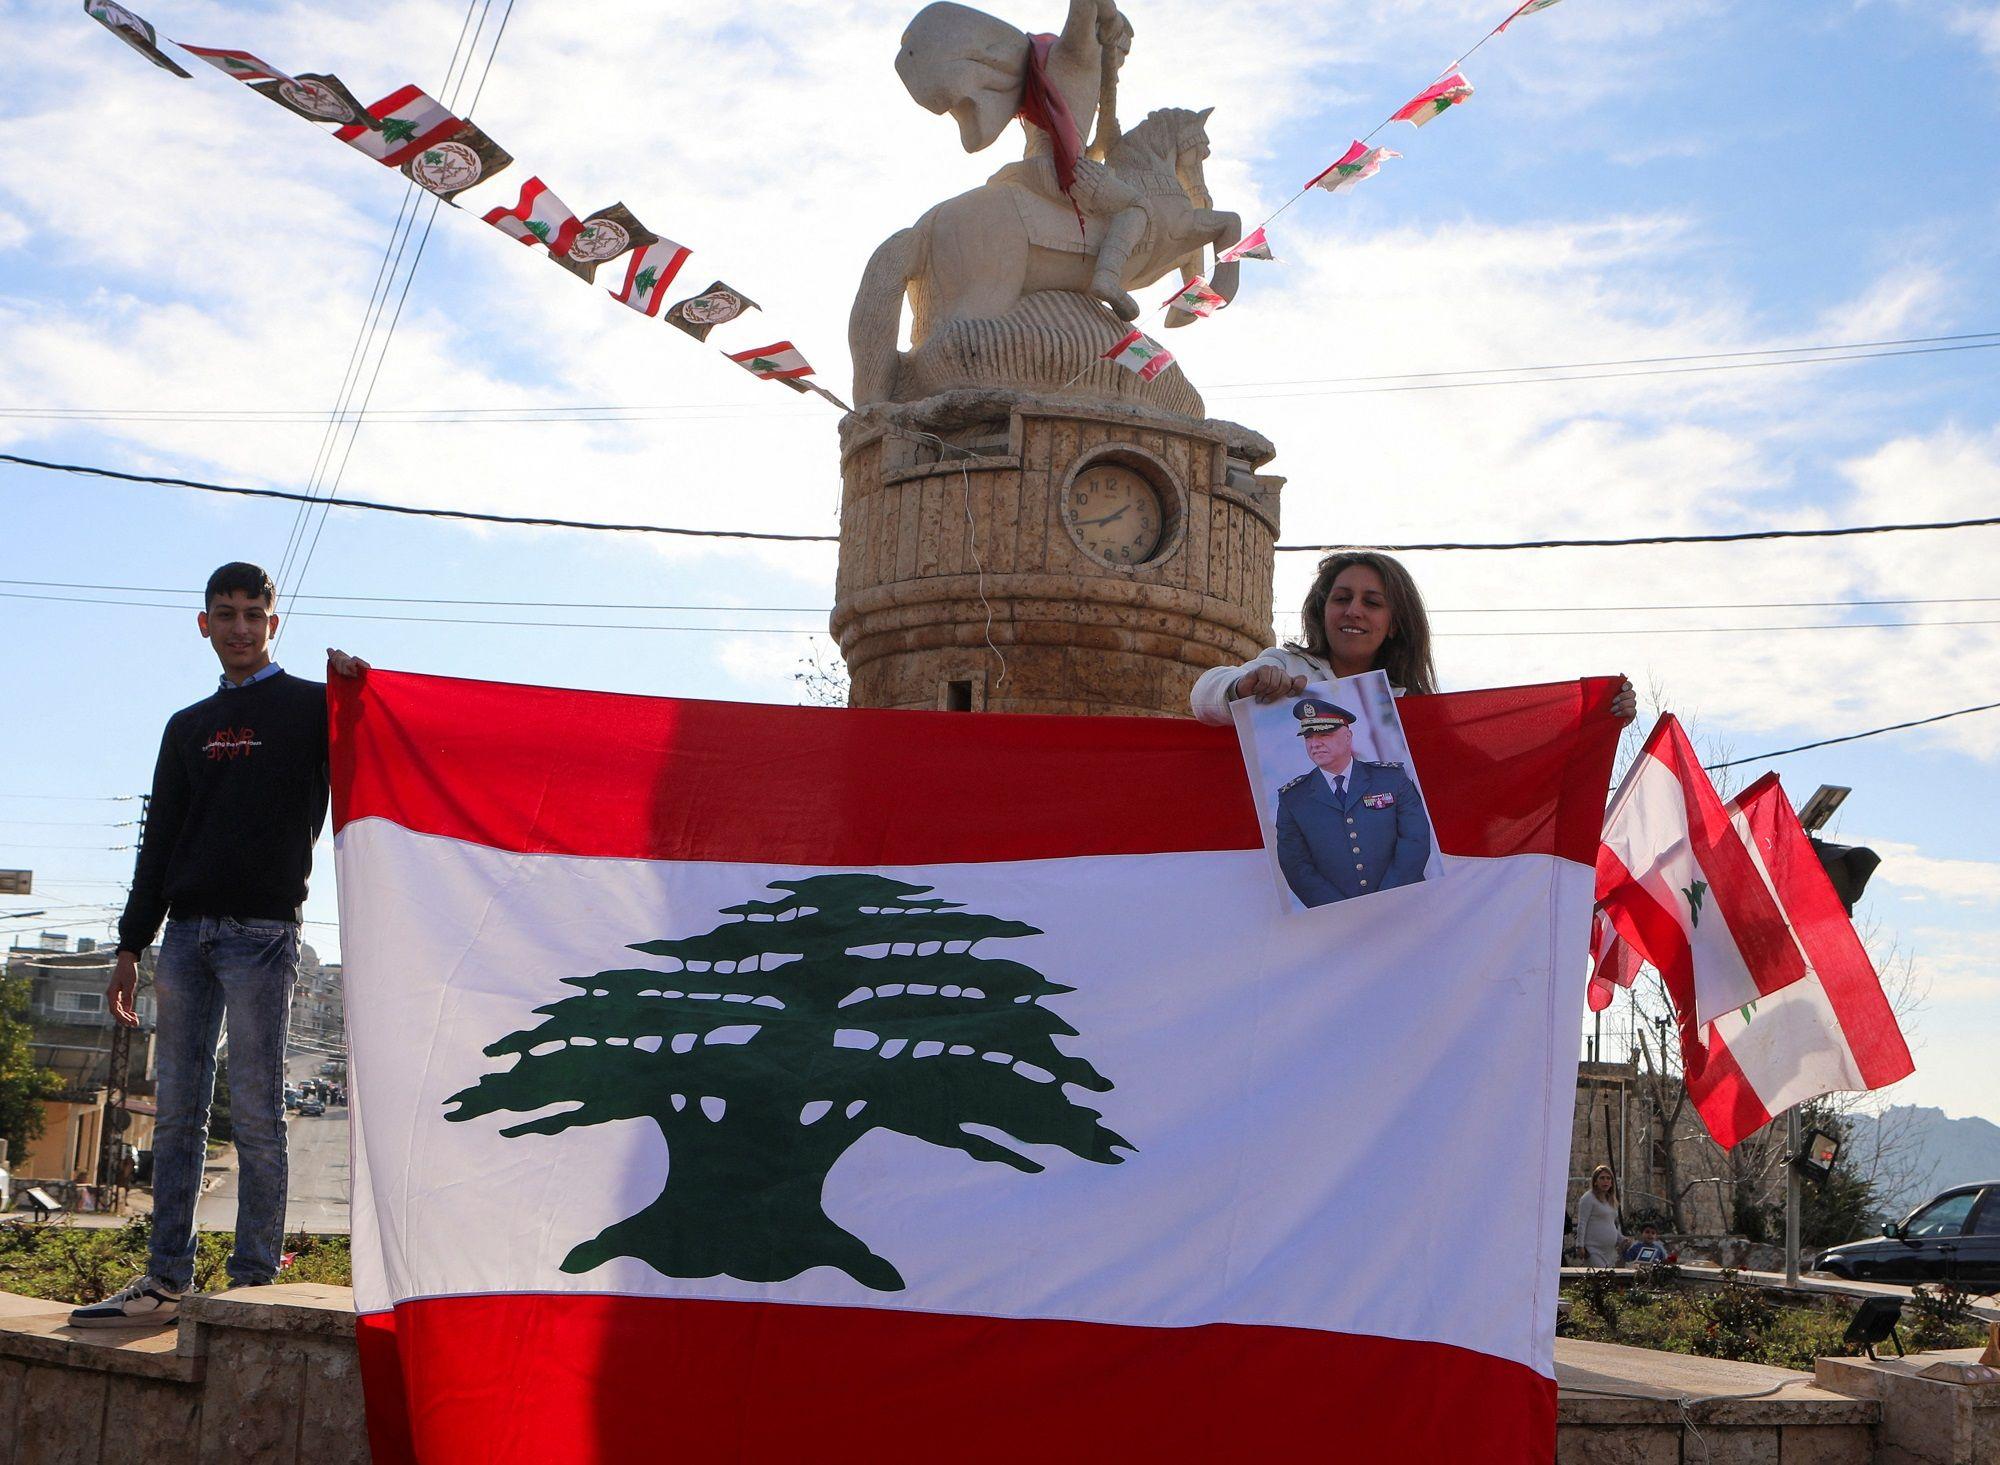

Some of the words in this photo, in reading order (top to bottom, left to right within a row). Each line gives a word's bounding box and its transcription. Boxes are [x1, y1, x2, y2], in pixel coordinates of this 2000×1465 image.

[1090, 481, 1099, 492] 11
[1106, 479, 1117, 491] 12
[1076, 493, 1088, 506] 10
[1137, 499, 1145, 512] 2
[1141, 517, 1149, 529] 3
[1135, 535, 1143, 546] 4
[1121, 546, 1130, 558] 5
